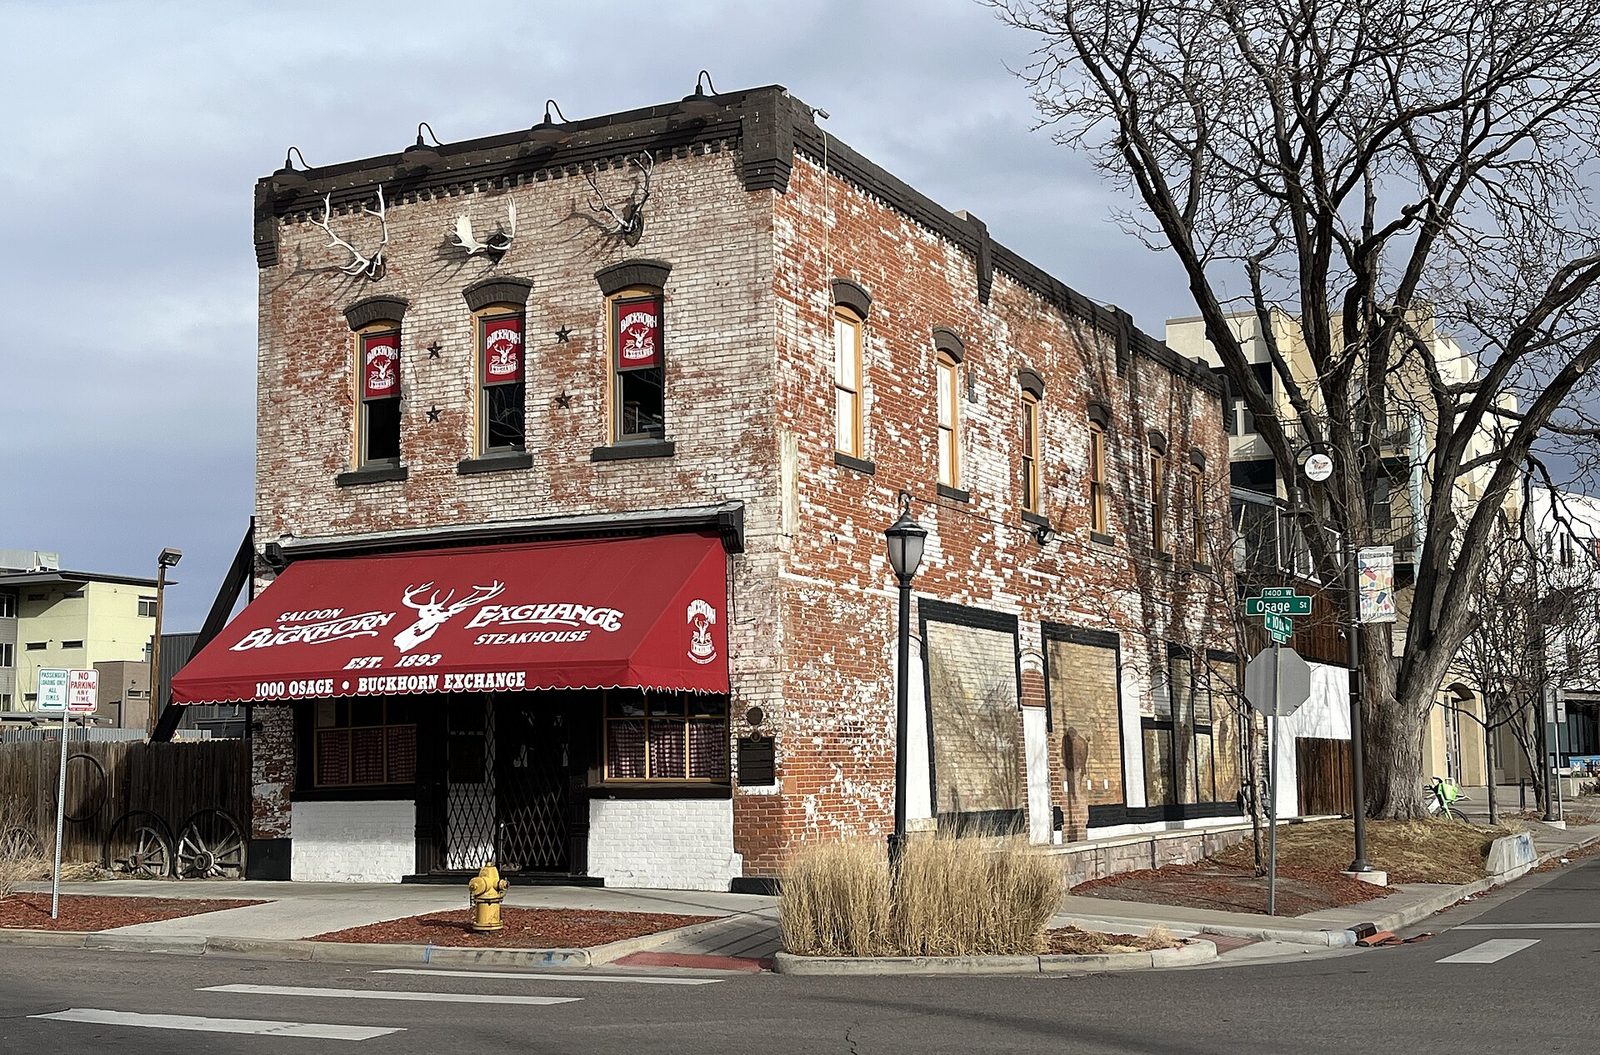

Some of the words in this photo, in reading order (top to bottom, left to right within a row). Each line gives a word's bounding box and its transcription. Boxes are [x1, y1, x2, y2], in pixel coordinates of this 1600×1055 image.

[620, 311, 657, 334] BUCKHORN
[1265, 589, 1282, 597] 1400
[1285, 589, 1292, 597] W
[1256, 600, 1291, 614] Osage
[1299, 601, 1307, 609] St
[276, 608, 344, 622] SALOON
[464, 603, 625, 632] EXCHANGE
[229, 612, 396, 651] BUCKHORN
[473, 630, 591, 645] STEAKHOUSE
[342, 656, 384, 670] EST.
[393, 654, 442, 668] 1893
[78, 672, 89, 681] NO
[70, 681, 96, 690] PARKING
[255, 682, 285, 697] 1000
[289, 679, 334, 695] OSAGE
[358, 674, 438, 692] BUCKHORN
[443, 672, 526, 689] EXCHANGE
